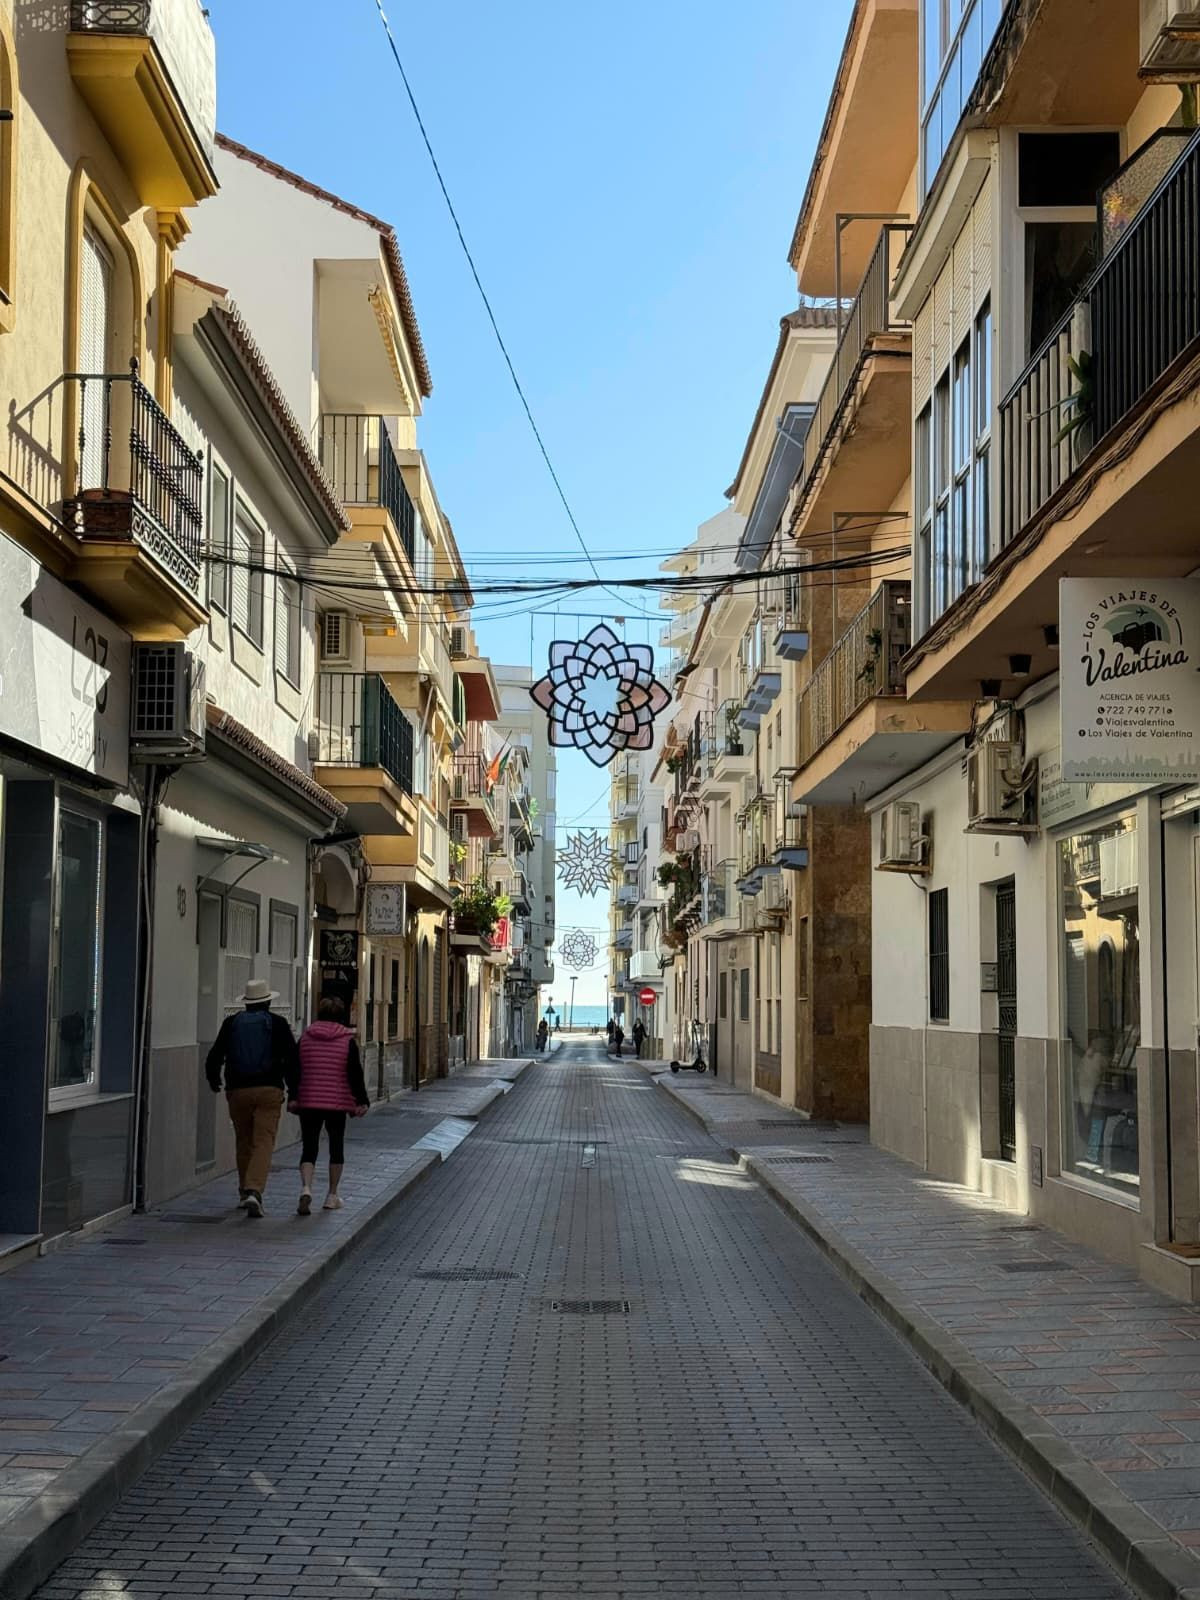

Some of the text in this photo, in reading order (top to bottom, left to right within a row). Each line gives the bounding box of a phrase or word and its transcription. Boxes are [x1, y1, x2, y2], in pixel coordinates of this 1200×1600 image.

[1083, 590, 1177, 639] LOS VIAJES DE
[1081, 647, 1189, 686] Valentina
[1100, 693, 1171, 701] AGENCIA DE VIAJES
[1106, 706, 1165, 714] 722 749 771
[1105, 717, 1175, 727] Viajesvalentina
[1088, 729, 1193, 739] Los Viajes de Valentina
